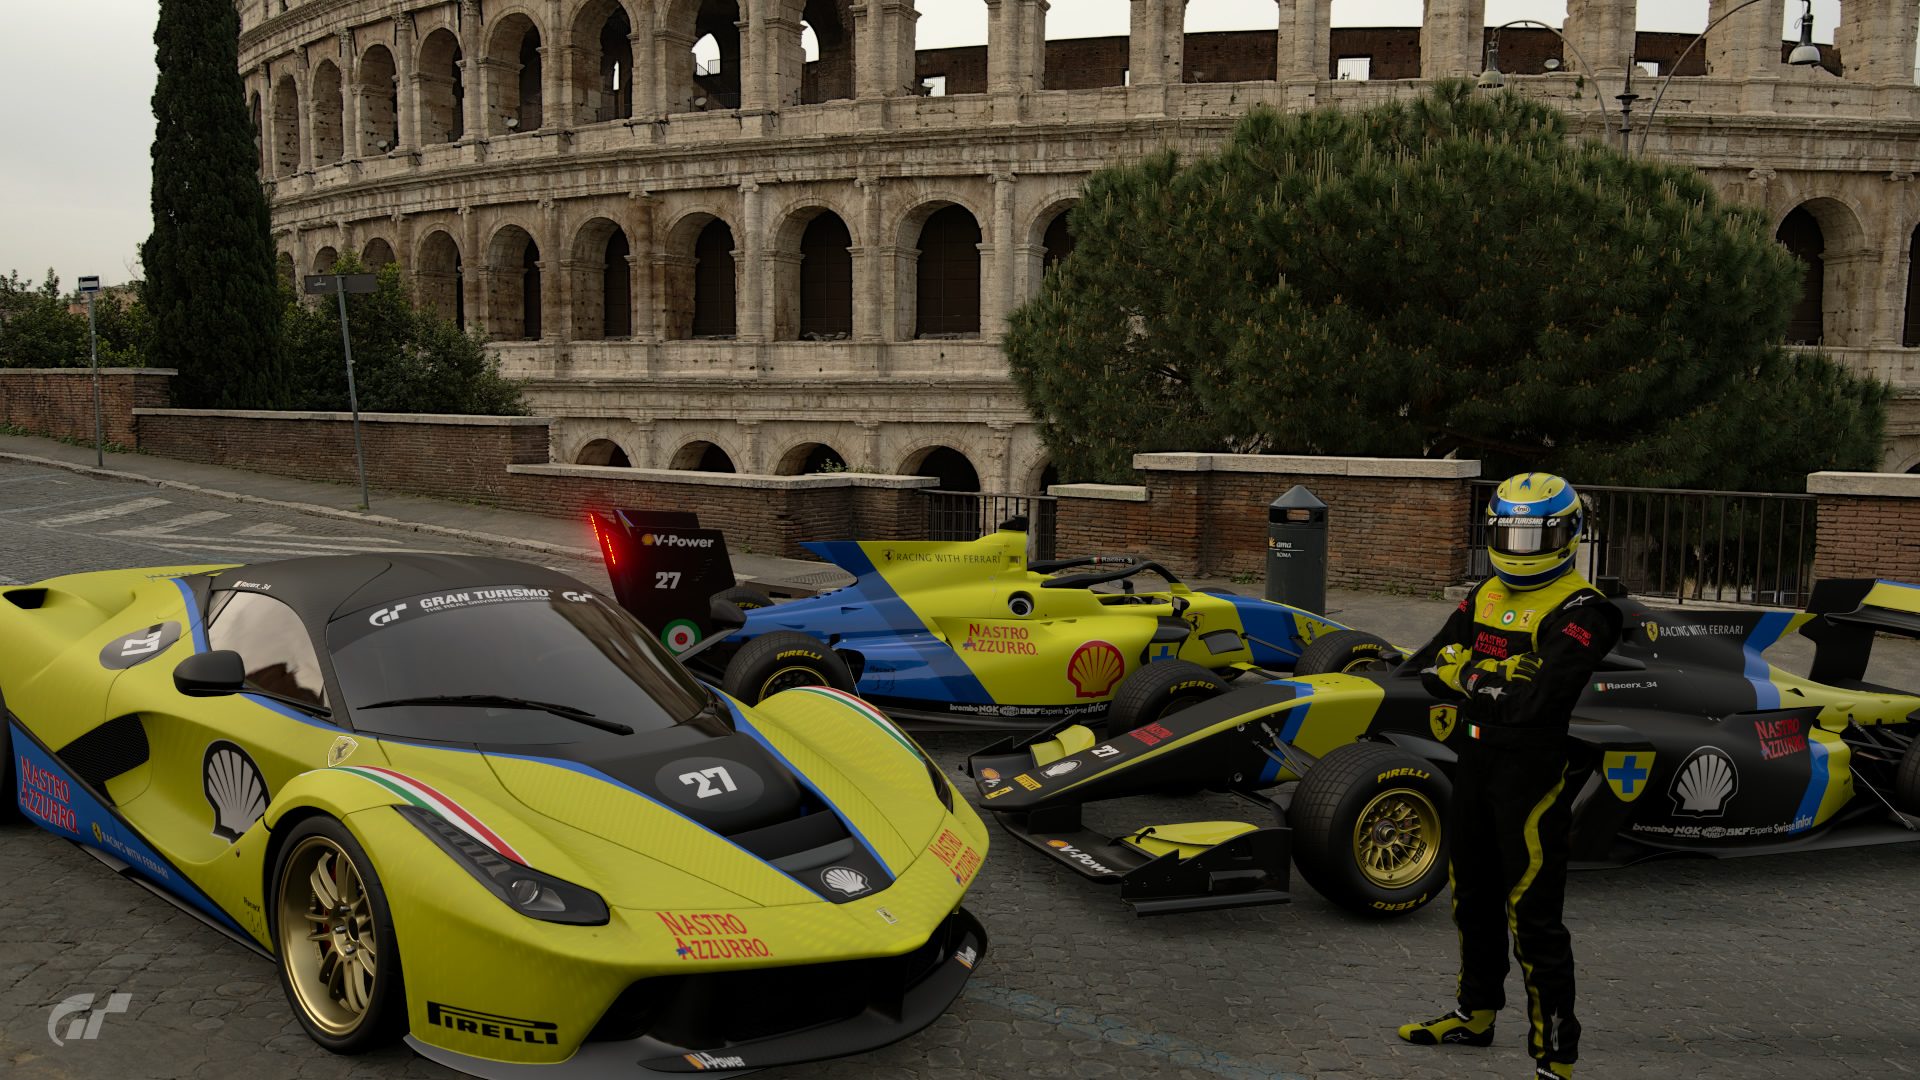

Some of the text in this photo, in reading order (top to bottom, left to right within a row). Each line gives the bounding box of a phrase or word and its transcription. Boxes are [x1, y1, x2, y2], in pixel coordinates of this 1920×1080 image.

[653, 534, 714, 548] V-Power
[1276, 541, 1292, 549] ama
[896, 553, 1001, 564] RACING WITH FERRARI
[654, 571, 681, 589] 27
[420, 588, 550, 609] GRAN TURISMO
[443, 601, 467, 609] REAL
[969, 624, 1029, 640] NASTRO
[1567, 622, 1592, 640] NASTRO
[1660, 624, 1744, 637] RACING WITH FERRARI
[1477, 631, 1508, 648] NASTRO
[776, 649, 823, 661] PIRELLI
[1170, 680, 1215, 695] P ZERO
[1607, 681, 1658, 690] Racerx_34
[950, 703, 979, 713] brembo
[979, 704, 1000, 713] NGK
[1087, 702, 1108, 714] infor
[1754, 717, 1800, 740] NASTRO
[20, 756, 71, 804] NASTRO
[679, 766, 737, 799] 27
[1376, 767, 1433, 784] PIRELLI
[1632, 822, 1675, 834] brembo
[1674, 825, 1702, 835] NGK
[1773, 821, 1796, 834] Swisse
[1795, 815, 1812, 829] infor
[1412, 840, 1428, 865] BBS
[1372, 900, 1416, 912] ZERO
[655, 911, 748, 936] NASTRO
[427, 1000, 559, 1045] PIRELLI
[689, 1051, 746, 1070] V-Power
